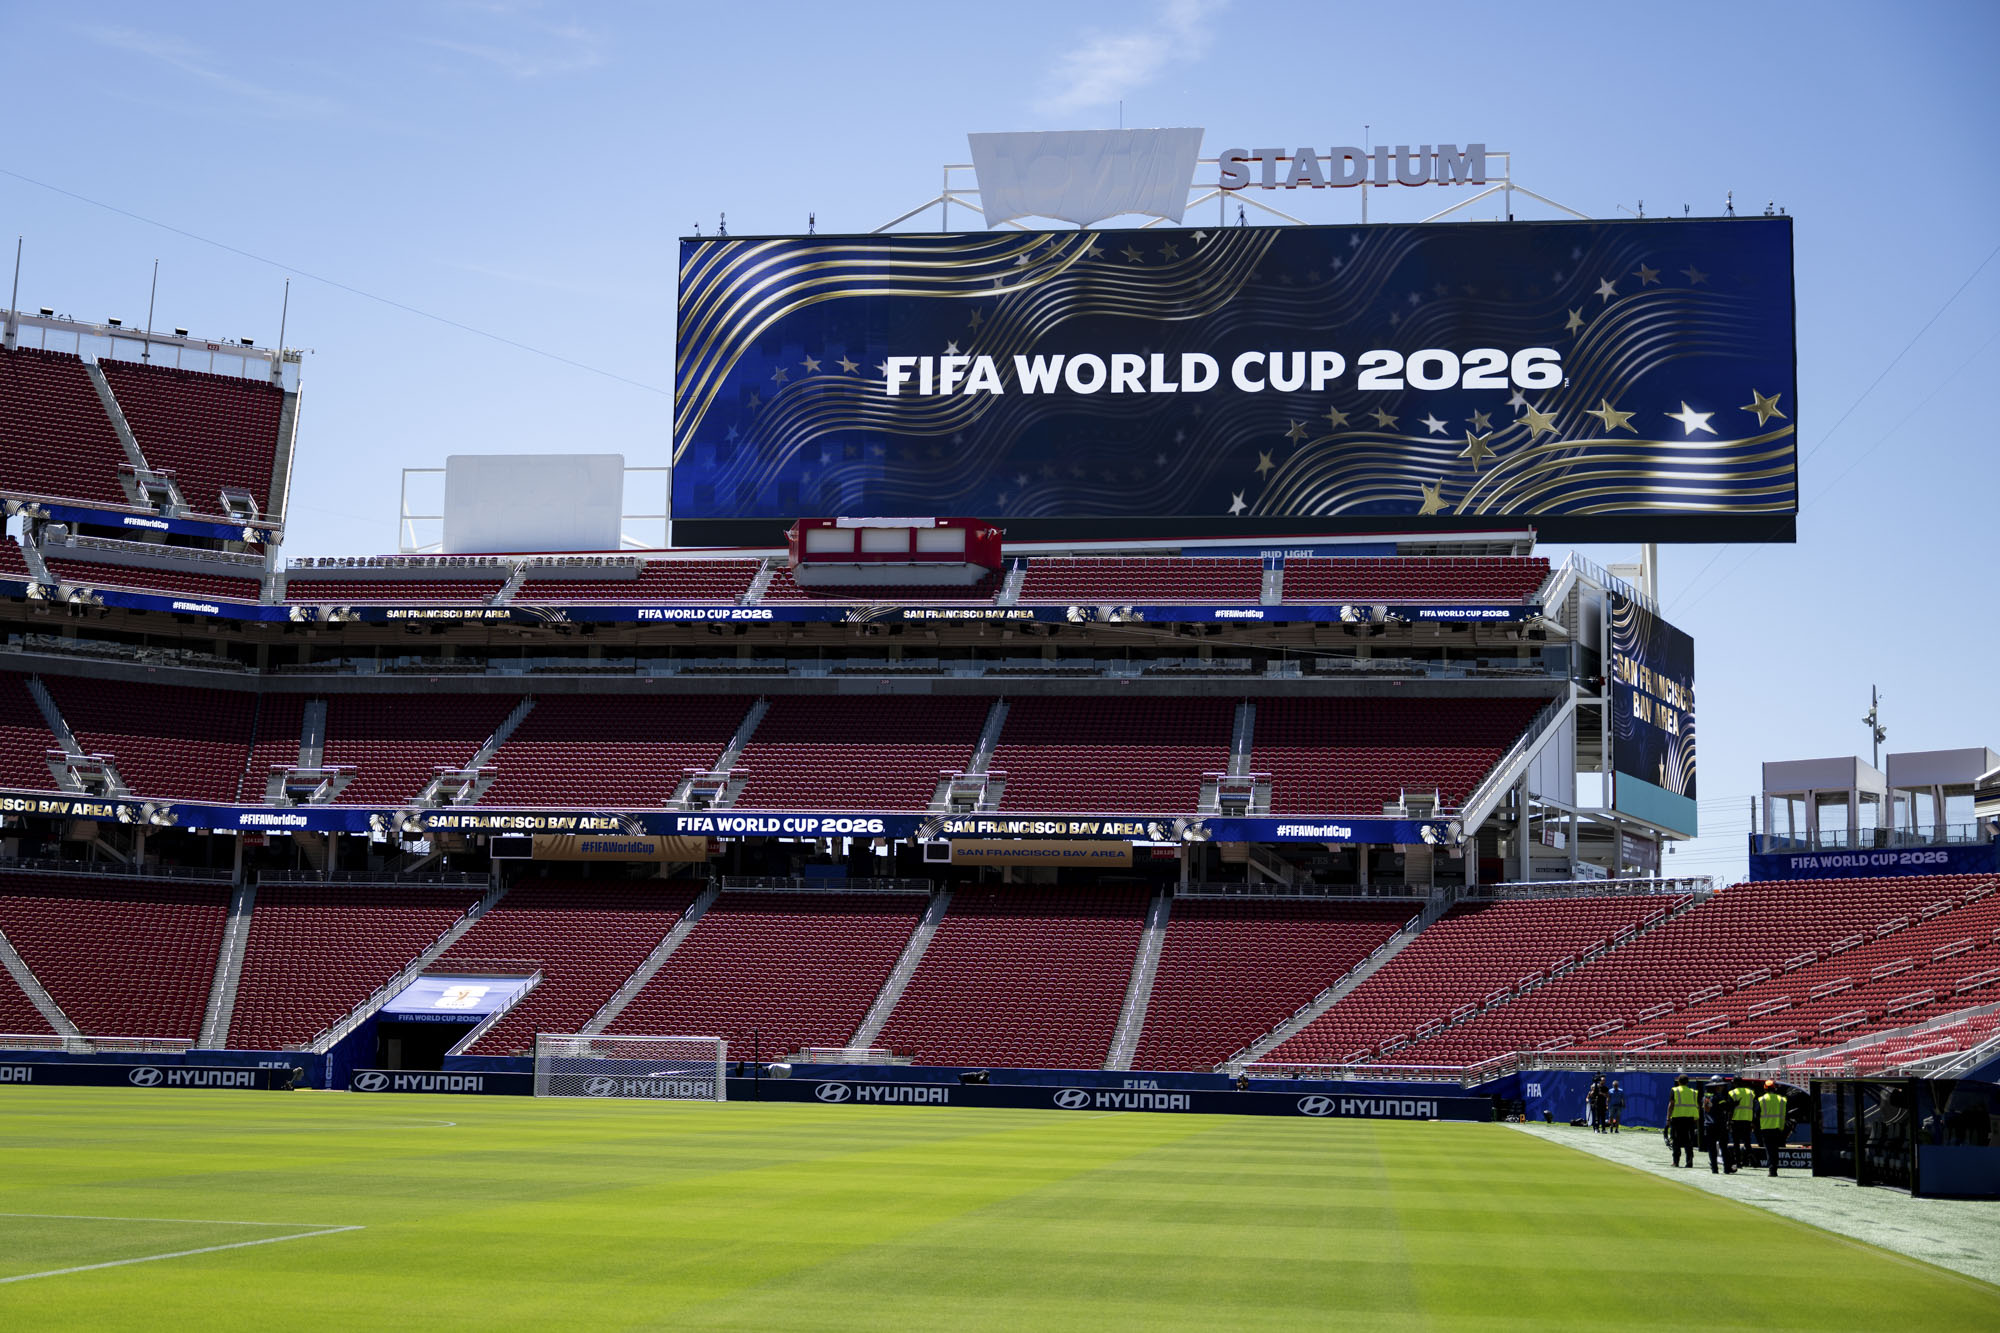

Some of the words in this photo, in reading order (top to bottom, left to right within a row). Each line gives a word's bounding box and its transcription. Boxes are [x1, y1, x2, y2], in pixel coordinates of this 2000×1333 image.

[1218, 143, 1486, 190] STADIUM
[886, 355, 1004, 396] FIFA
[1014, 353, 1219, 394] WORLD
[1232, 350, 1346, 393] CUP
[1358, 347, 1563, 391] 2026
[123, 517, 169, 530] #FIFAWorldCup
[1260, 550, 1282, 559] BUD
[1284, 550, 1314, 558] LIGHT
[172, 601, 219, 614] #FIFAWorldCup
[386, 610, 406, 618] SAN
[408, 610, 463, 618] FRANCISCO
[464, 610, 484, 618] BAY
[485, 610, 511, 618] AREA
[638, 609, 662, 619] FIFA
[664, 609, 705, 619] WORLD
[707, 609, 731, 619] CUP
[732, 610, 774, 619] 2026
[903, 610, 925, 618] SAN
[926, 610, 984, 618] FRANCISCO
[985, 610, 1006, 618] BAY
[1006, 610, 1034, 618] AREA
[1214, 609, 1264, 619] #FIFAWorldCup
[1616, 653, 1639, 687] SAN
[1639, 665, 1693, 714] FRANCISCO
[1633, 691, 1652, 724] BAY
[1654, 703, 1680, 737] AREA
[38, 800, 70, 814] BAY
[71, 803, 114, 817] AREA
[239, 813, 308, 827] #FIFAWorldCup
[428, 815, 459, 828] SAN
[461, 816, 546, 829] FRANCISCO
[547, 817, 577, 829] BAY
[579, 818, 620, 830] AREA
[677, 817, 715, 832] FIFA
[716, 818, 781, 832] WORLD
[783, 818, 819, 832] CUP
[821, 819, 884, 833] 2026
[943, 821, 976, 833] SAN
[977, 821, 1067, 834] FRANCISCO
[1069, 823, 1100, 835] BAY
[1102, 823, 1145, 835] AREA
[1276, 824, 1352, 839] #FIFAWorldCup
[581, 841, 655, 855] #FIFAWorldCup
[957, 848, 984, 856] SAN
[986, 848, 1062, 857] FRANCISCO
[1063, 849, 1088, 857] BAY
[1090, 850, 1125, 858] AREA
[1791, 857, 1819, 869] FIFA
[1820, 854, 1869, 868] WORLD
[1871, 853, 1898, 866] CUP
[1899, 851, 1948, 865] 2026
[398, 1014, 414, 1022] FIFA
[414, 1014, 440, 1022] WORLD
[456, 1015, 482, 1023] 2026
[168, 1070, 255, 1086] HYUNDAI
[394, 1075, 484, 1091] HYUNDAI
[1123, 1079, 1159, 1089] FIFA
[623, 1079, 714, 1096] HYUNDAI
[857, 1086, 949, 1103] HYUNDAI
[1527, 1083, 1542, 1098] FIFA
[1096, 1092, 1190, 1110] HYUNDAI
[1341, 1099, 1437, 1117] HYUNDAI
